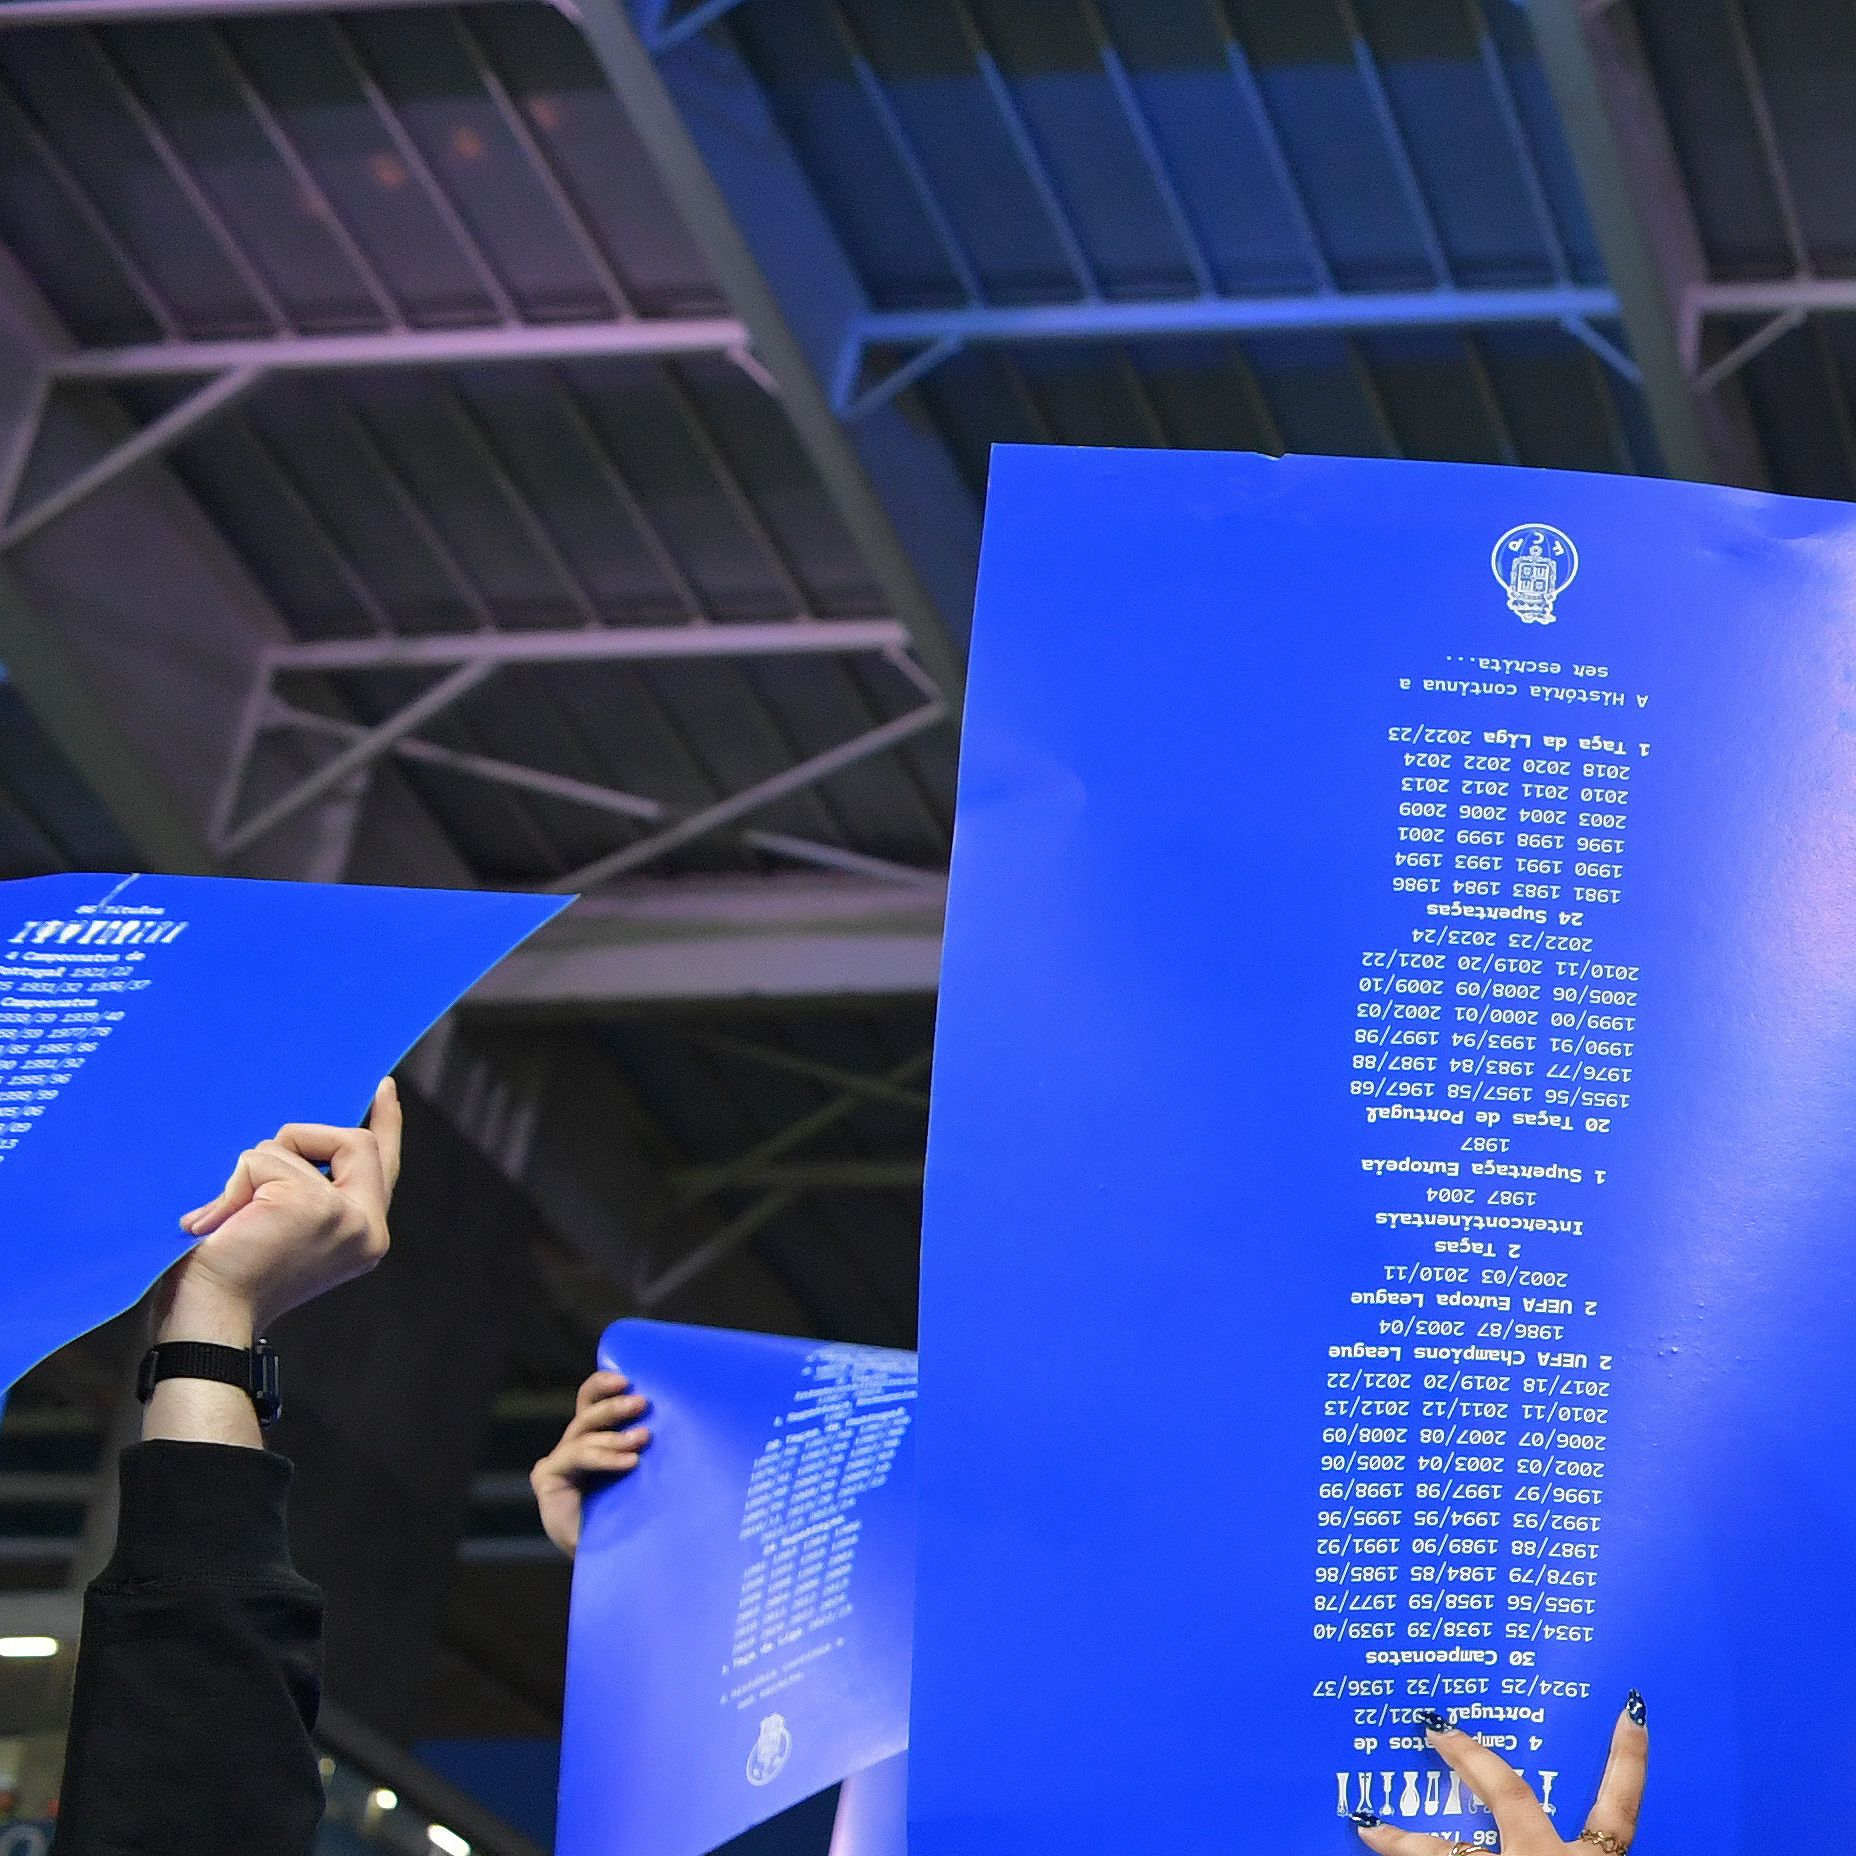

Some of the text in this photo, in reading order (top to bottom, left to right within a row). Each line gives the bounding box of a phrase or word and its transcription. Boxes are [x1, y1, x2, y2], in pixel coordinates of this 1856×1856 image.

[1446, 655, 1610, 679] ser escrita...
[1398, 676, 1650, 709] A História continua a
[1352, 1050, 1633, 1084] 1976/77 1983/84 1987/88
[1360, 1156, 1608, 1186] 1 Supertaça Europeia
[1375, 1212, 1585, 1237] Intercontinentais
[1328, 1341, 1614, 1371] 2 UEFA Champions League
[1314, 1588, 1597, 1616] 1955/56 1958/59 1977/78
[1446, 1702, 1545, 1725] Portugal
[1353, 1730, 1544, 1755] 4 Campatos de
[1472, 1829, 1498, 1846] 86
